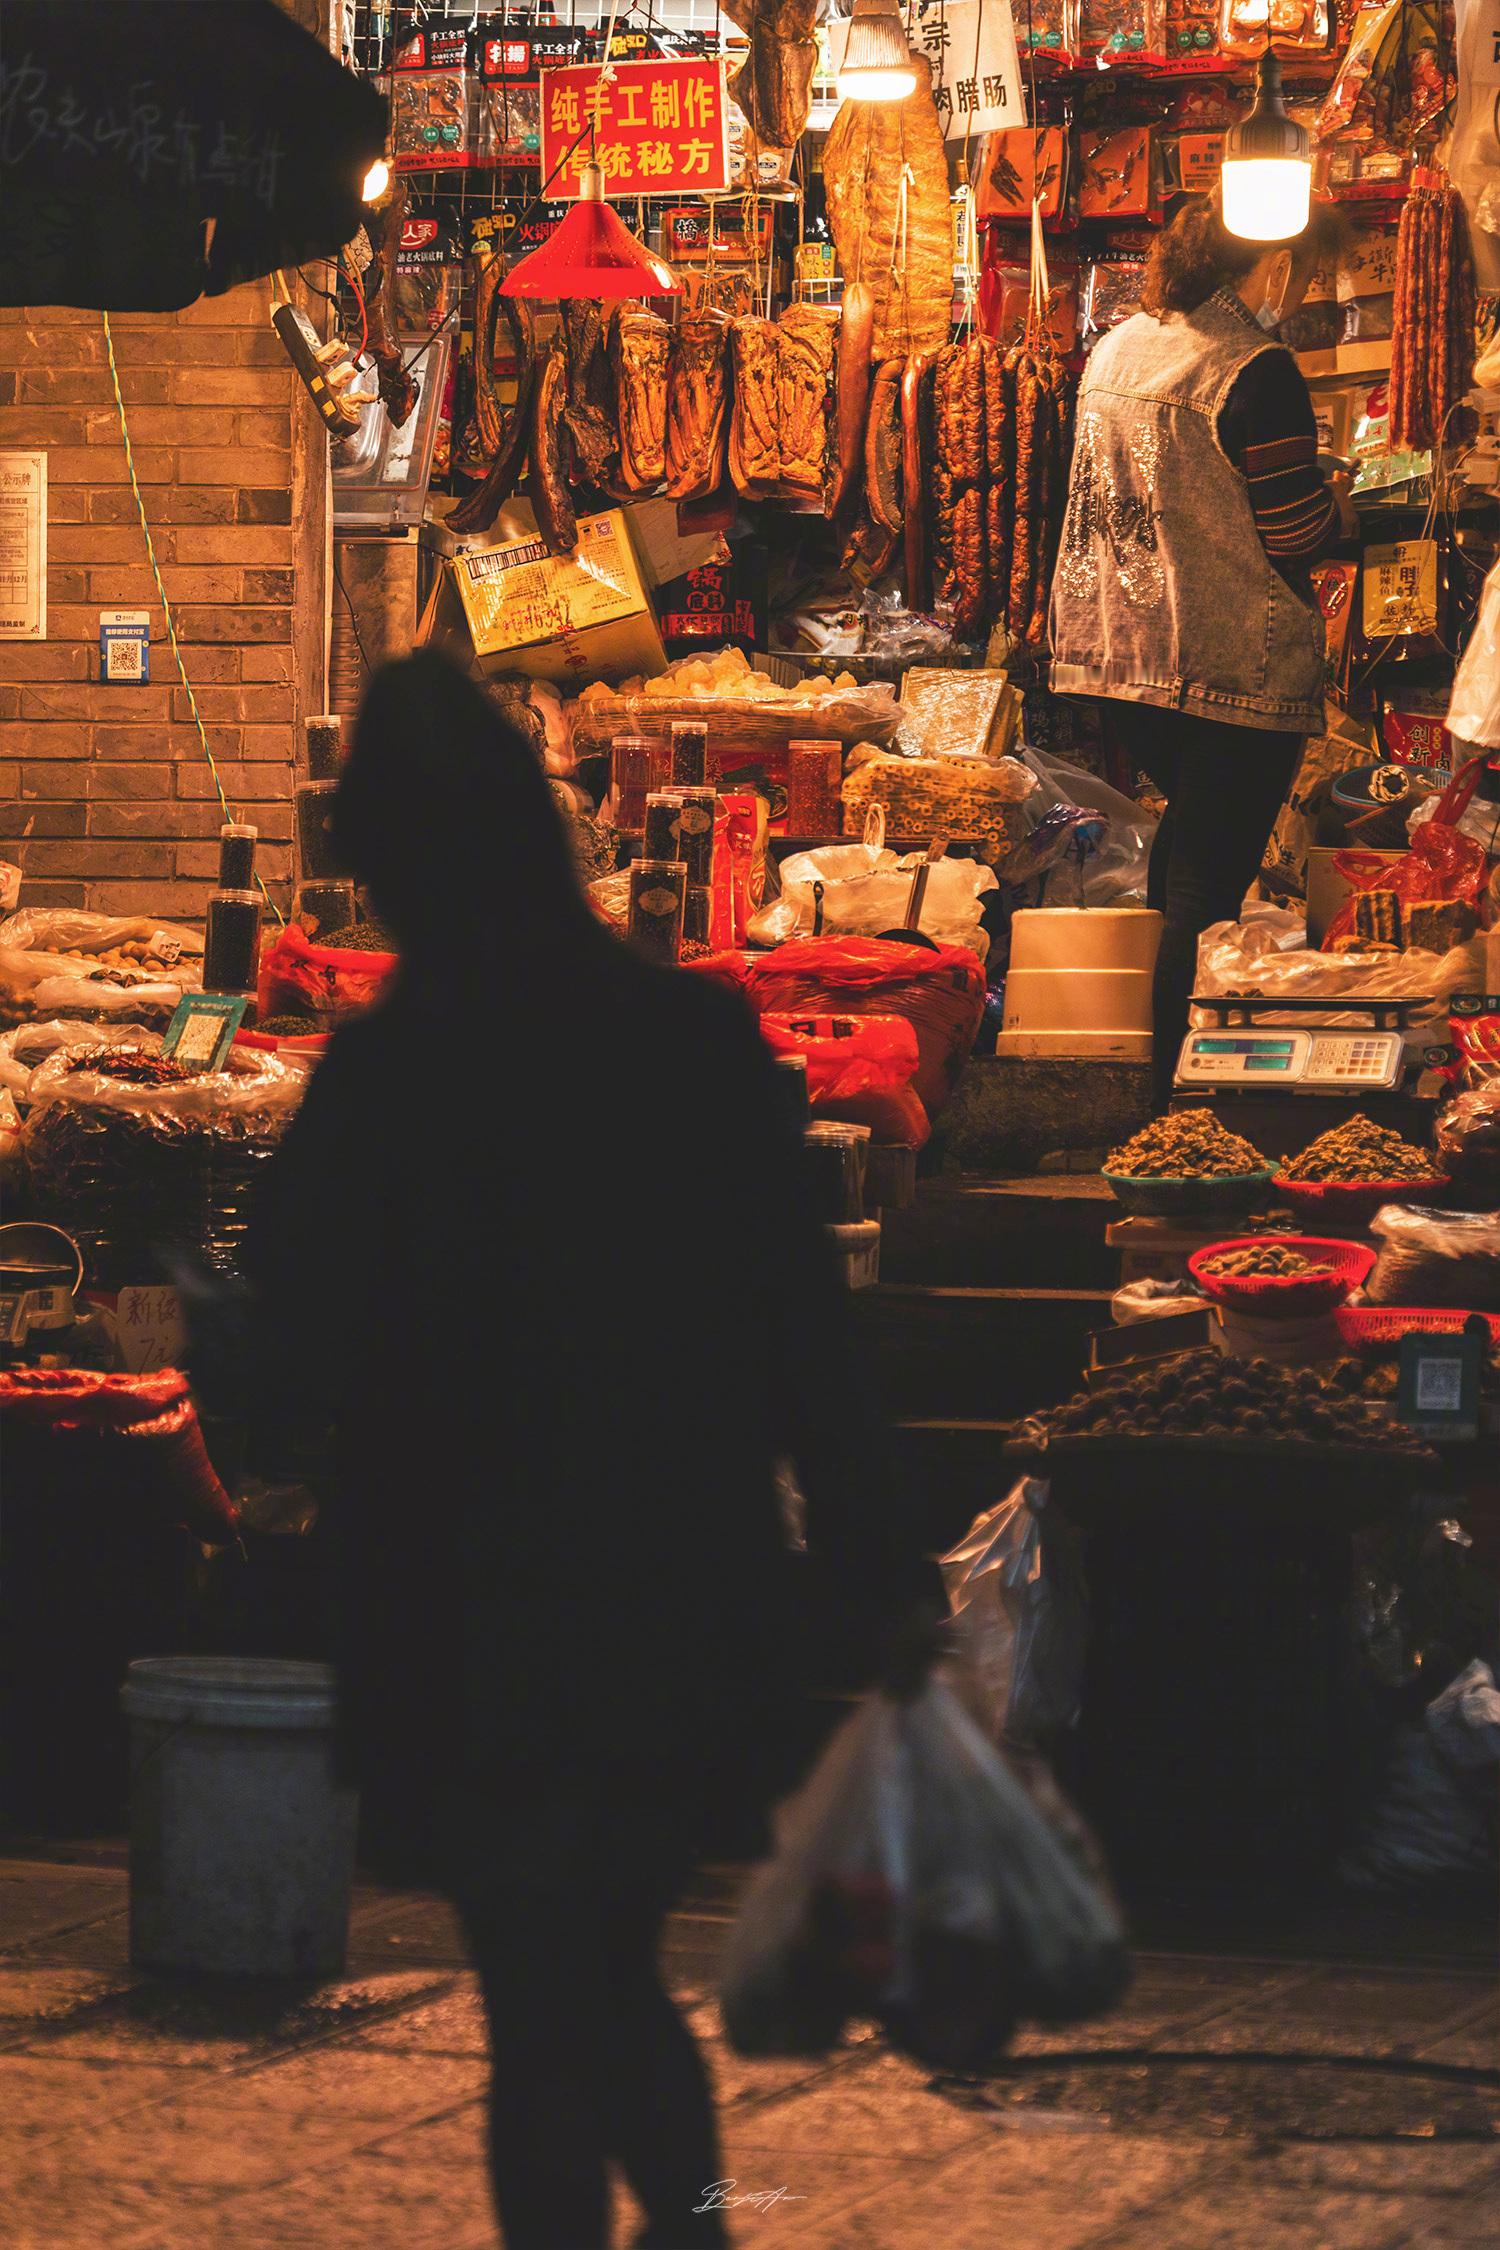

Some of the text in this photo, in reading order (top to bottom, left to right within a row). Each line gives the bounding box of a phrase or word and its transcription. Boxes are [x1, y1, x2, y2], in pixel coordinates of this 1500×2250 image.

[551, 79, 715, 134] 纯手工制作
[932, 74, 1007, 115] 肉腊肠
[555, 138, 715, 182] 传统秘方
[403, 224, 433, 240] 人家
